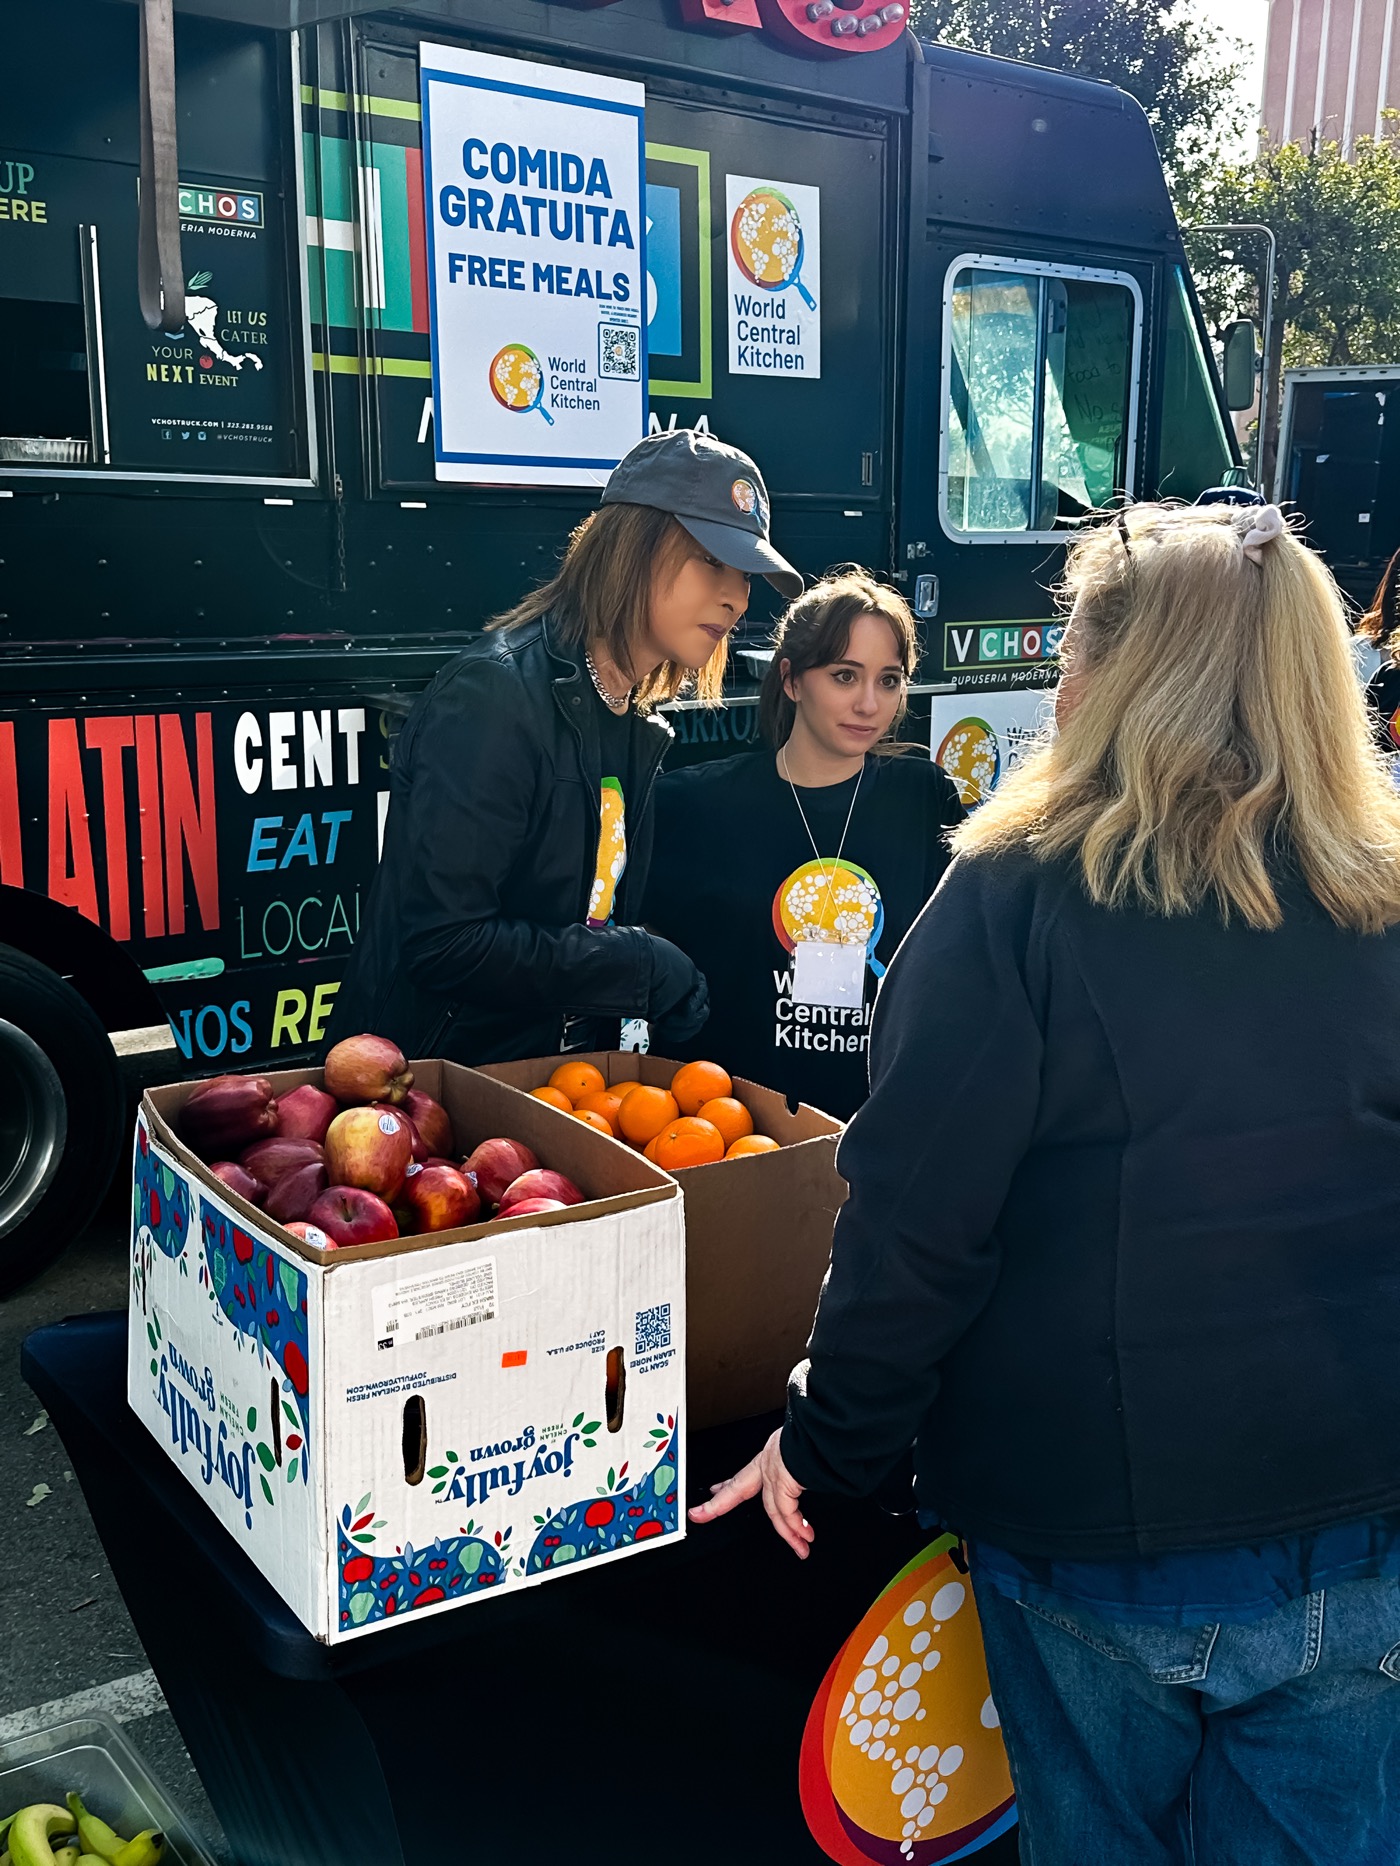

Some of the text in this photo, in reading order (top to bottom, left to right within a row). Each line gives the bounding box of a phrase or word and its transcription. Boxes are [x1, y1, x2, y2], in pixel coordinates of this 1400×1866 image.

[462, 137, 613, 199] COMIDA
[439, 185, 635, 250] GRATUITA
[208, 227, 257, 239] MODERNA
[448, 251, 630, 302] FREE MEALS
[734, 293, 786, 320] World
[227, 310, 267, 326] LET US
[220, 329, 268, 345] CATER
[737, 320, 801, 346] Central
[151, 346, 193, 361] YOUR
[737, 345, 805, 371] Kitchen
[548, 356, 586, 374] World
[147, 363, 239, 387] NEXT EVENT
[551, 376, 597, 393] Central
[551, 393, 600, 411] Kitchen
[151, 418, 219, 428] VCHOSTRUCK.COM
[951, 670, 1059, 685] PUPUSERIA MODERNA
[234, 708, 365, 794] CENT
[246, 810, 352, 872] EAT
[775, 998, 870, 1026] Central
[593, 1329, 605, 1338] CAT
[565, 1344, 574, 1353] OF
[575, 1337, 605, 1350] PRODUCE
[653, 1349, 676, 1361] LEARN
[639, 1359, 669, 1374] SCAN TO
[167, 1340, 216, 1412] grown
[346, 1372, 457, 1403] DISTRIBUTED BY CHELAN FRESH
[539, 1429, 567, 1441] CHELAN
[541, 1423, 564, 1433] FRESH
[156, 1353, 255, 1531] joyfully
[470, 1425, 535, 1462] grown
[443, 1433, 580, 1508] joyfully
